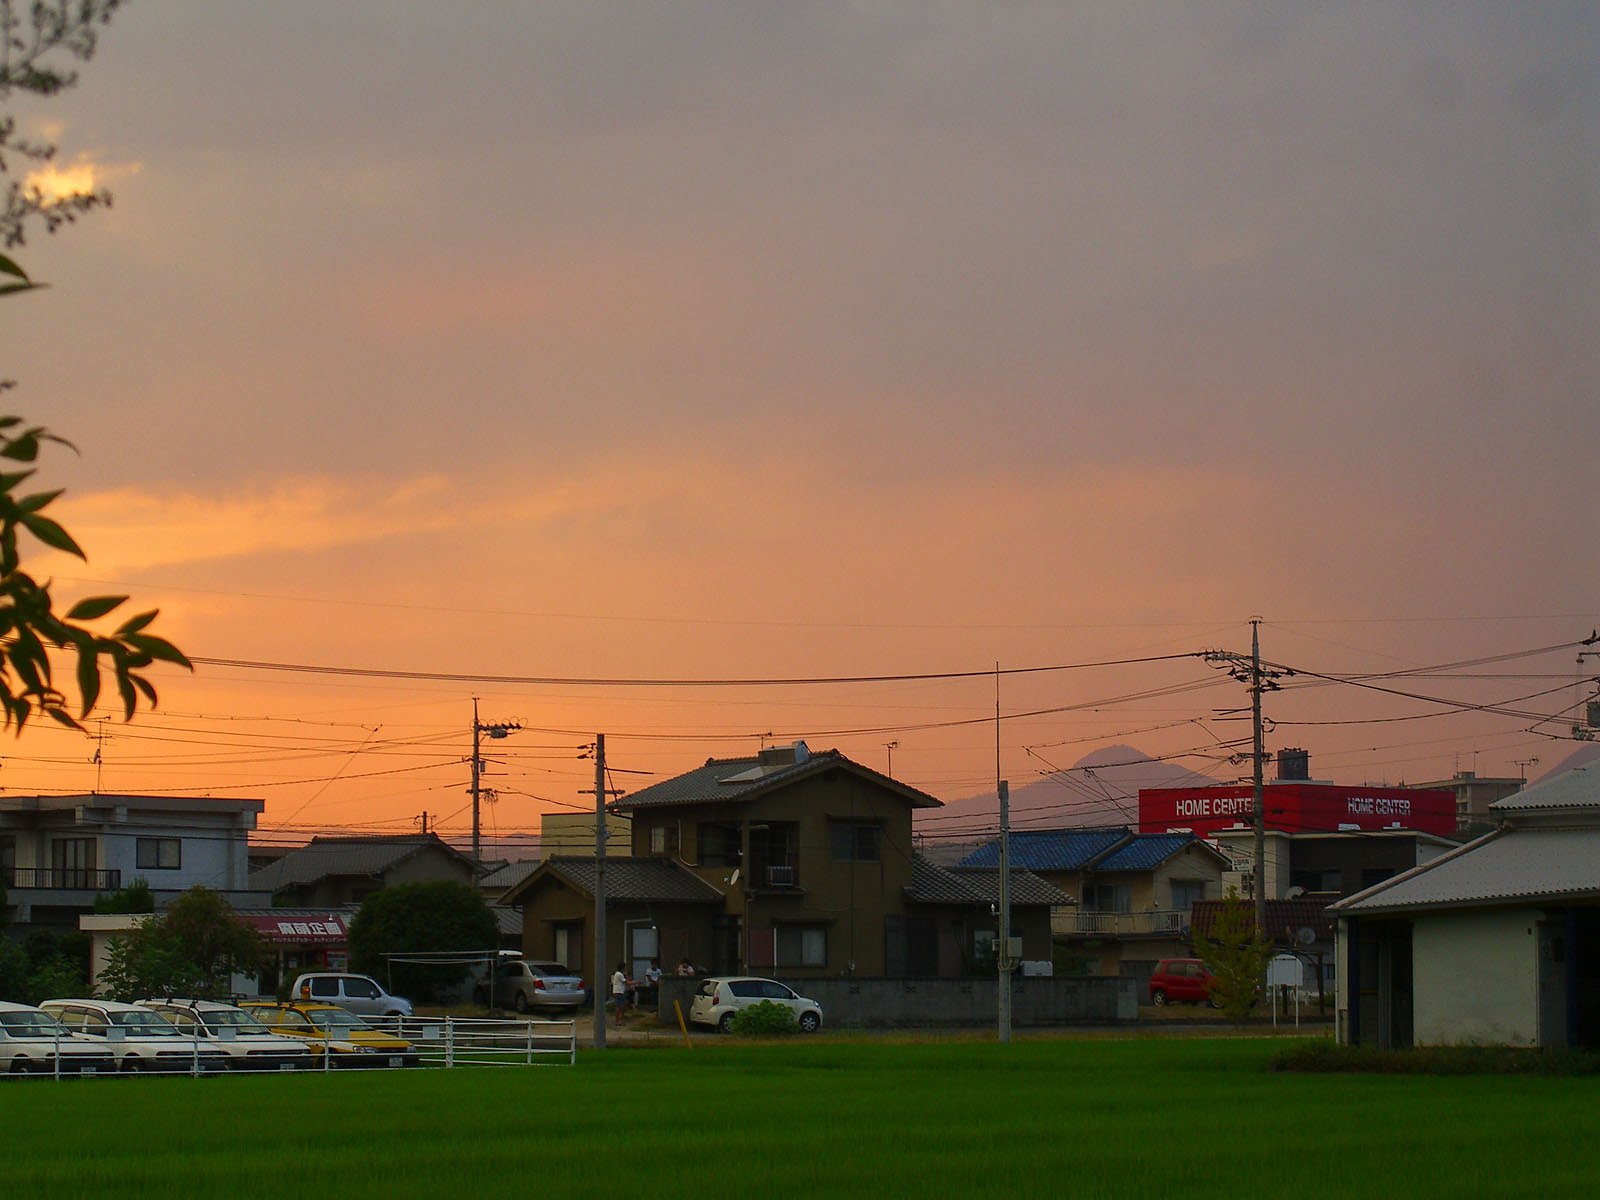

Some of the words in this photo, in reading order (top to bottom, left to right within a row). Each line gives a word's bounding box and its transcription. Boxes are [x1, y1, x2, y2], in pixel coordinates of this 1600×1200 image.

[1176, 799, 1210, 816] HOME
[1213, 797, 1254, 815] CENTE
[1347, 797, 1374, 814] HOME
[1375, 798, 1411, 816] CENTER
